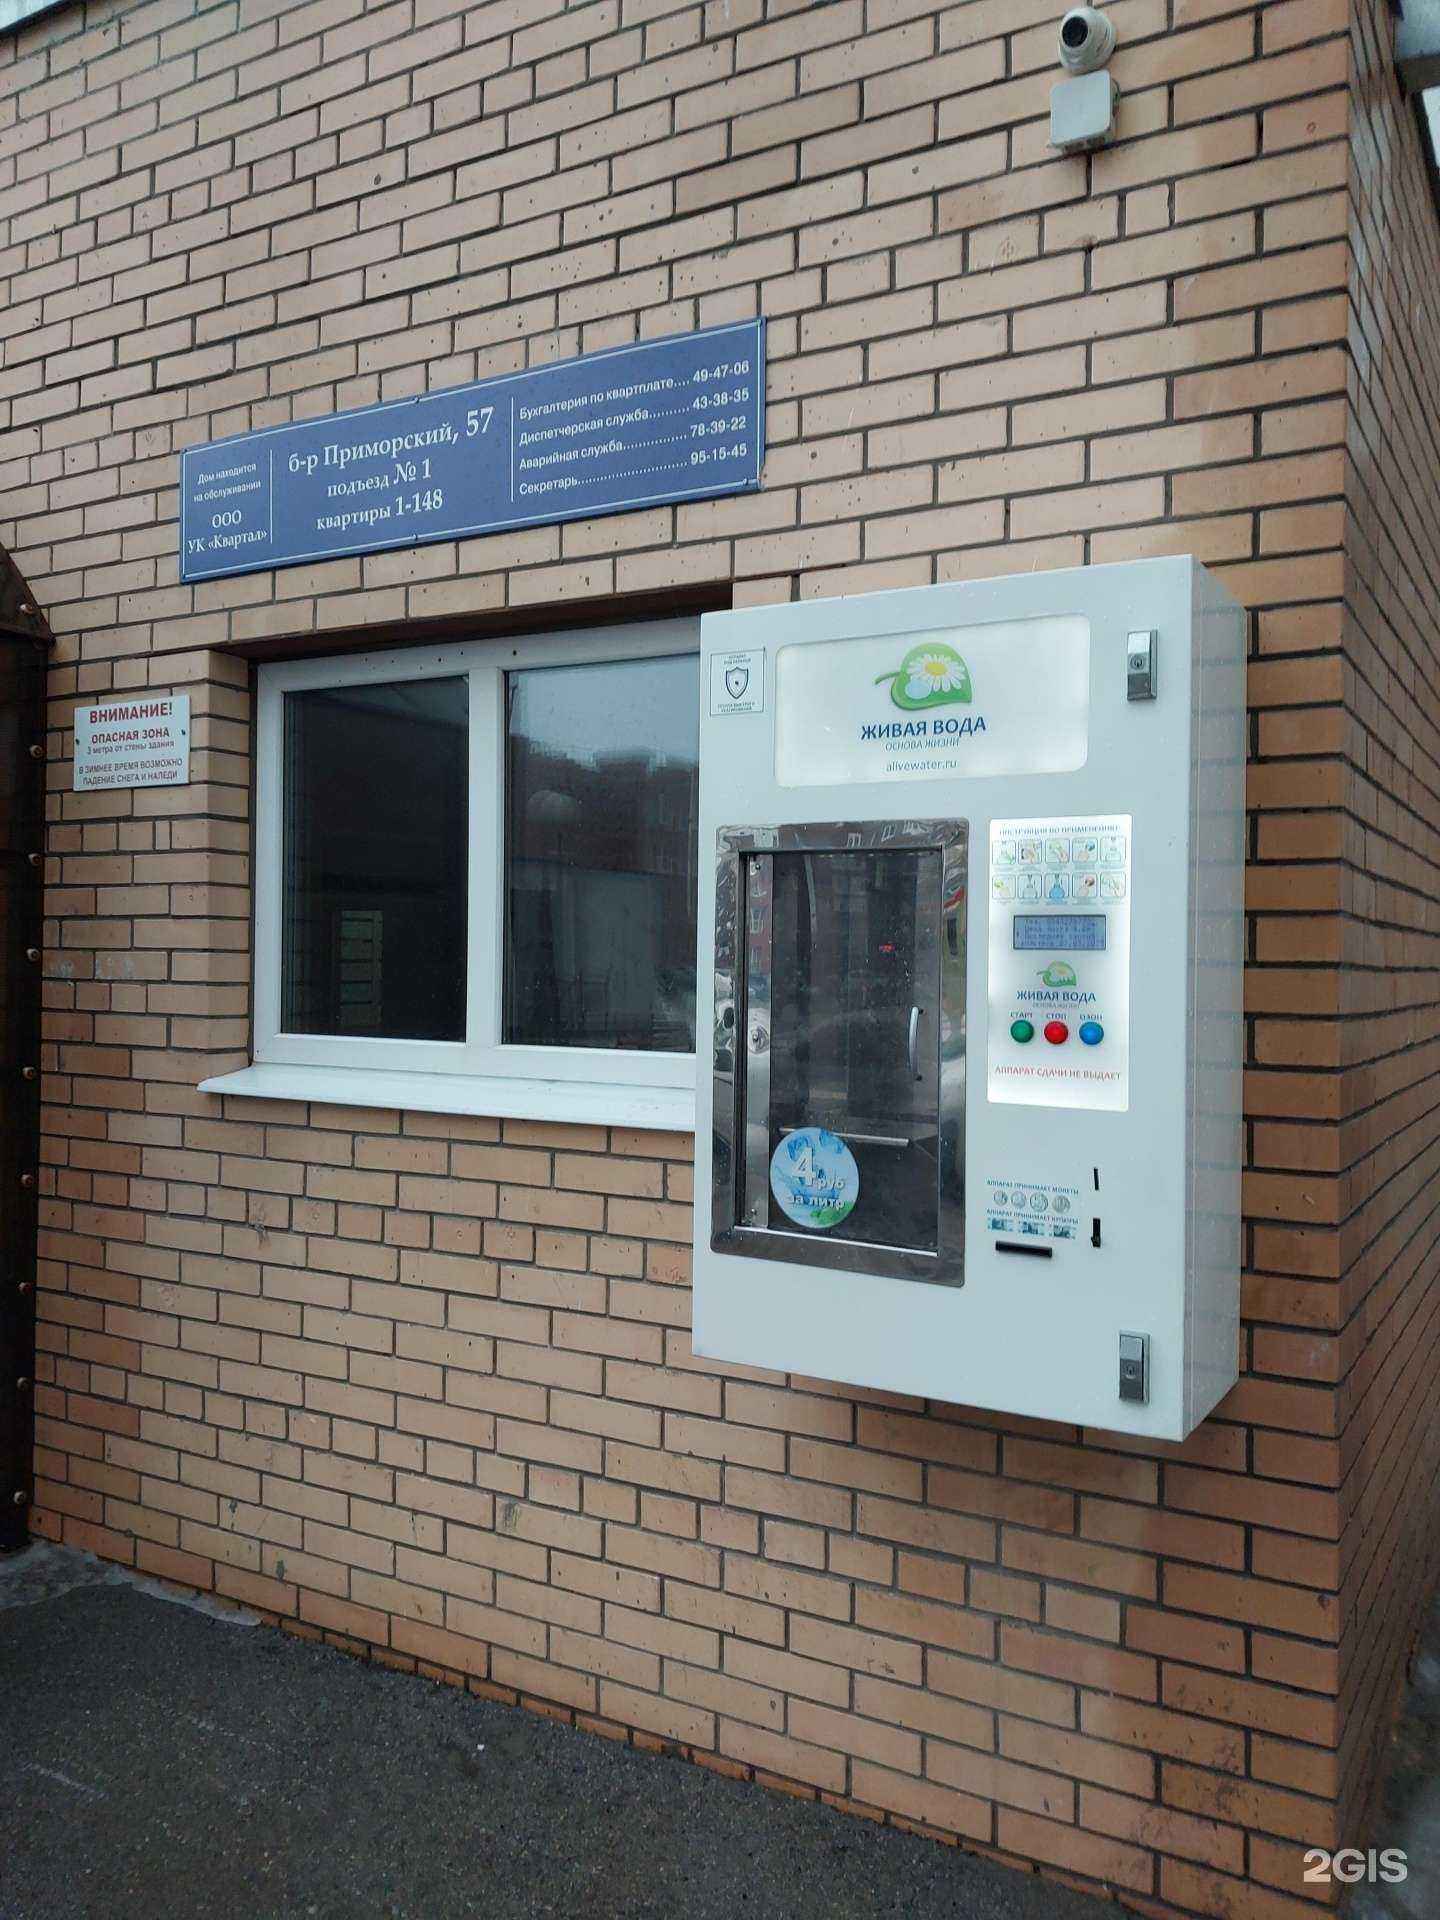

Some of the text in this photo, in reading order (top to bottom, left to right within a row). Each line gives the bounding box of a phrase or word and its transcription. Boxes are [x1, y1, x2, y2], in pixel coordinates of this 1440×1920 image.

[519, 394, 588, 420] Бухгалтерия
[590, 391, 604, 403] по
[693, 360, 750, 384] 49-47-06
[288, 406, 494, 475] б-р Приморский, 57
[519, 418, 604, 447] Диспетчерская
[519, 448, 579, 471] Аварийная
[690, 415, 747, 439] 78-39-22
[690, 443, 747, 466] 95-15-45
[197, 463, 257, 485] Дом находится
[327, 458, 432, 497] подъезд № 1
[193, 480, 262, 503] на обслуживании
[212, 508, 242, 529] ООО
[316, 488, 443, 531] квартиры 1-148
[188, 529, 268, 554] УК «Квартал»
[89, 702, 173, 724] ВНИМАНИЕ!
[91, 726, 170, 745] ОПАСНАЯ ЗОНА
[861, 716, 986, 740] ЖИВАЯ ВОДА
[885, 736, 960, 752] ОСНОВА ЖИЗНИ
[79, 758, 183, 775] В ЗИМНЕЕ ВРЕМЯ ВОЗМОЖНО
[886, 759, 958, 773] alivewater.ru
[83, 771, 178, 786] ПАДЕНИЕ СНЕГА И НАЛЕДИ
[1016, 990, 1097, 1003] ЖИВАЯ ВОДА
[1010, 1011, 1033, 1020] СТАРТ
[1045, 1012, 1067, 1021] СТОП
[995, 1065, 1034, 1076] АППАРАТ
[1036, 1067, 1067, 1079] СДАЧИ
[1069, 1069, 1080, 1078] НЕ
[792, 1146, 814, 1187] 4
[809, 1197, 845, 1211] литр
